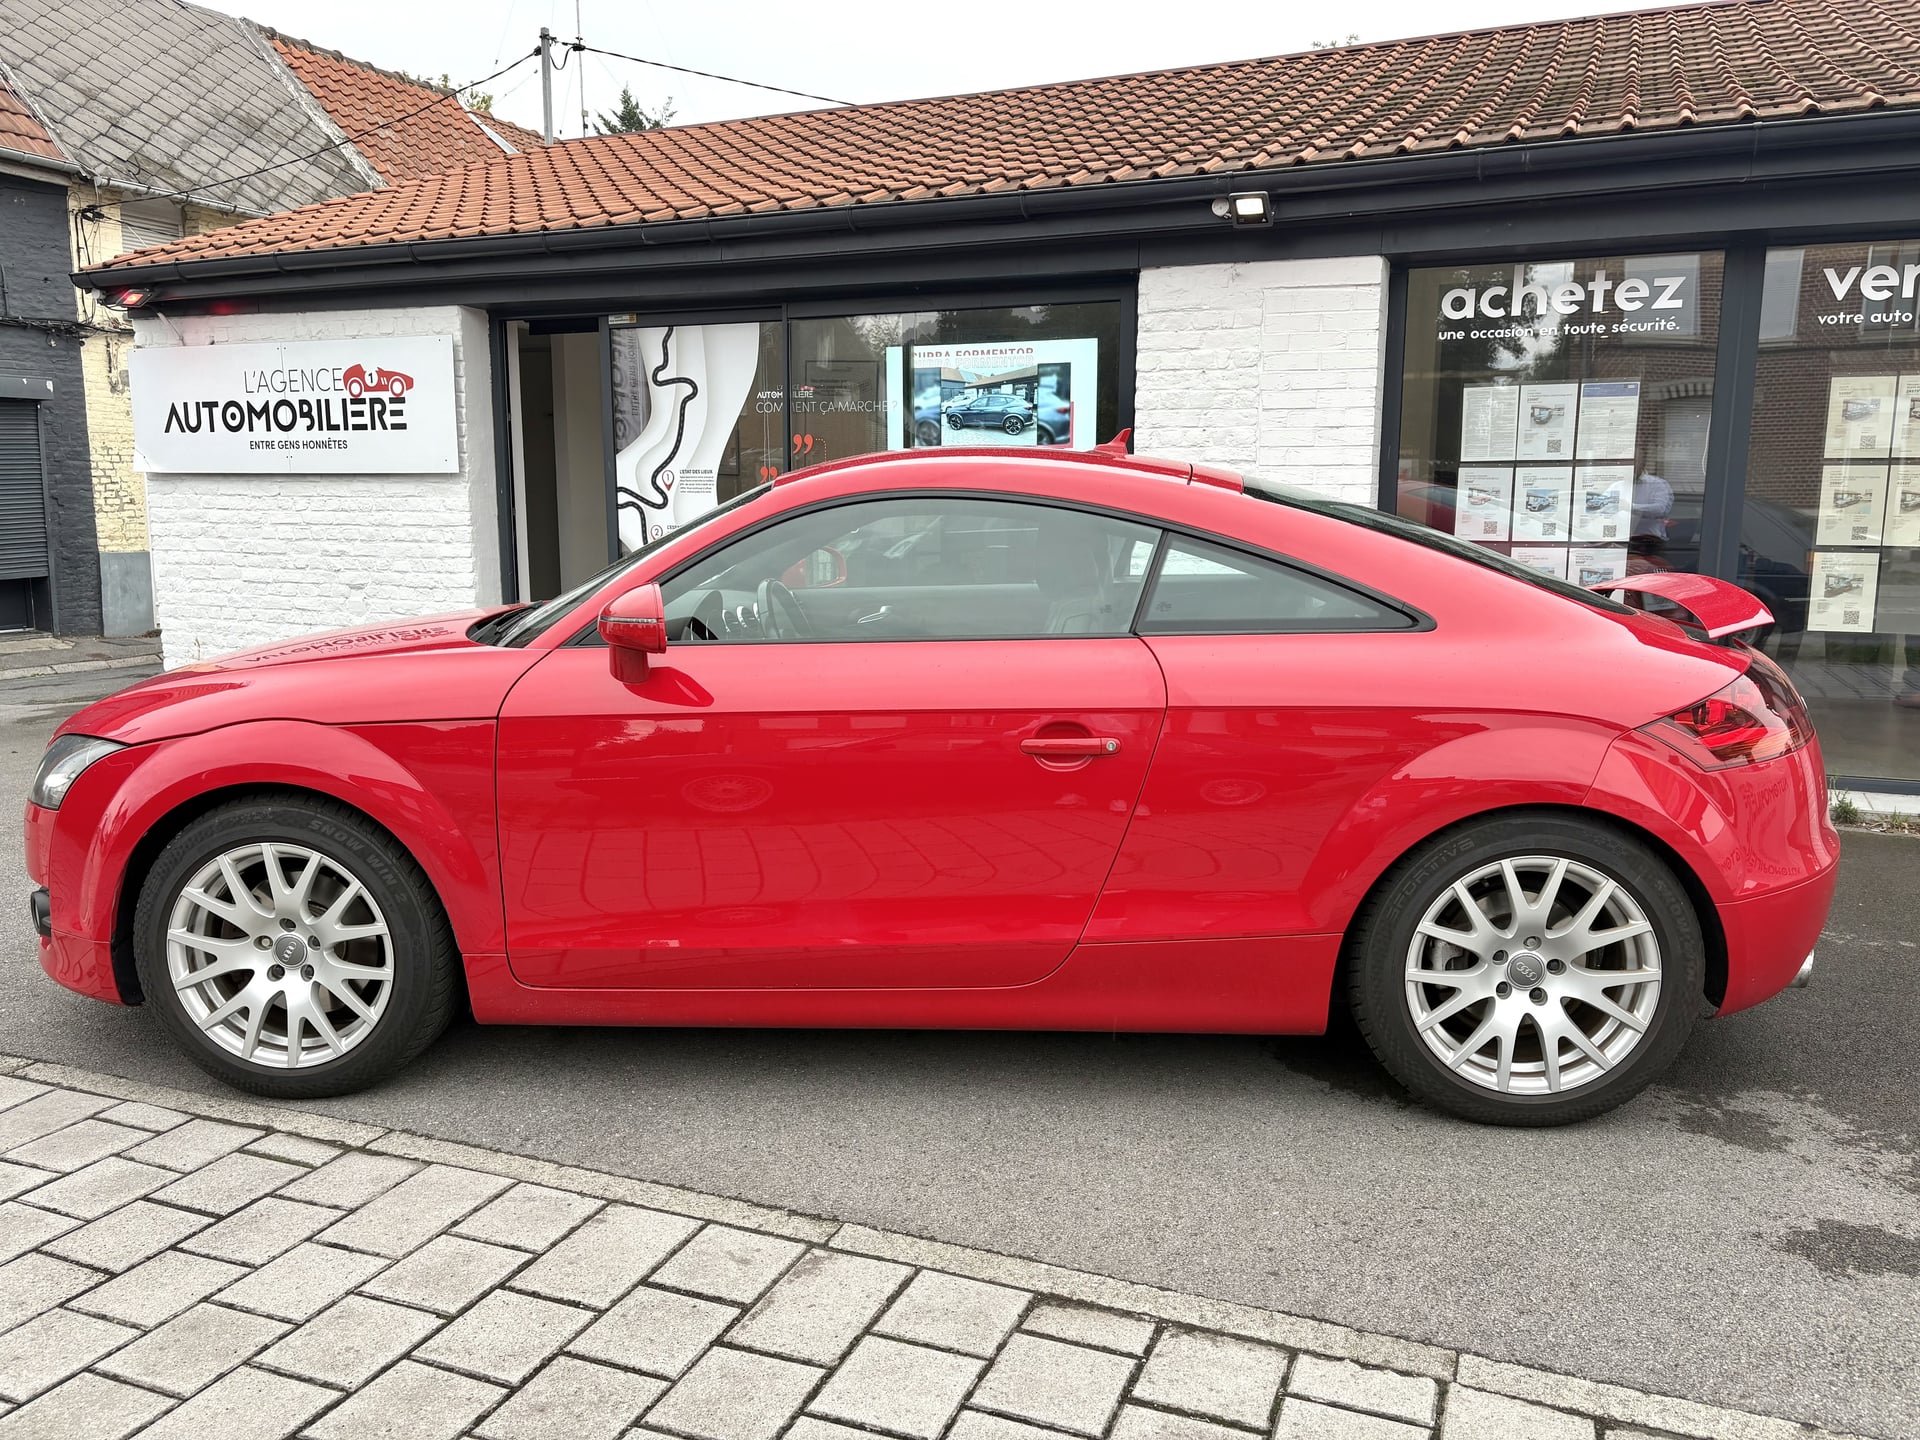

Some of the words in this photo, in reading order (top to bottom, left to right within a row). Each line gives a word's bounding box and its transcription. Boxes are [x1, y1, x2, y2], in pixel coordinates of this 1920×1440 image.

[1441, 264, 1687, 320] achetez
[1438, 330, 1466, 341] une
[1470, 325, 1534, 339] occasion
[1539, 326, 1558, 337] en
[1563, 323, 1606, 335] toute
[1611, 315, 1680, 333] sécurité.
[1817, 311, 1864, 325] votre
[1870, 309, 1913, 323] auto
[244, 367, 344, 393] L'AGENCE
[755, 401, 817, 413] COMENT
[820, 401, 835, 415] ÇA
[838, 400, 888, 412] MARCHE
[250, 440, 276, 450] ENTRE
[278, 440, 300, 450] GENS
[302, 437, 348, 450] HONNÊTES
[308, 820, 365, 851] SNOW
[366, 854, 398, 886] WIN
